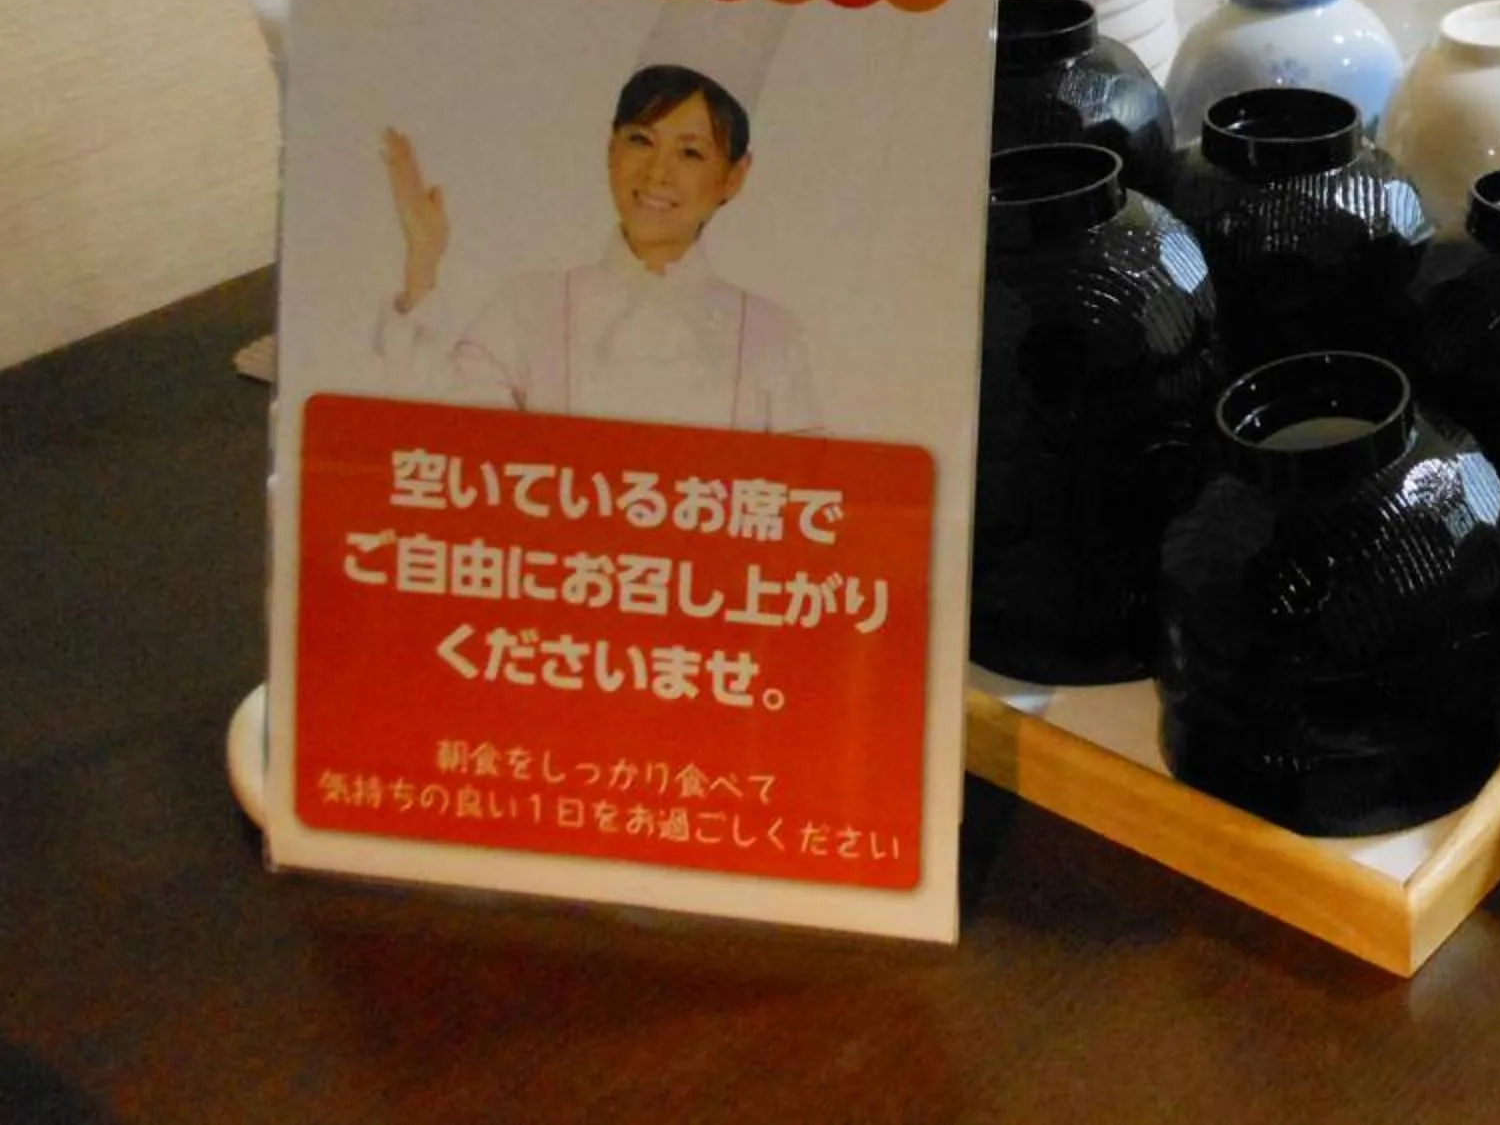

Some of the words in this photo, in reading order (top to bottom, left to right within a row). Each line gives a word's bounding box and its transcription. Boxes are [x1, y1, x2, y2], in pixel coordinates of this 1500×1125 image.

[389, 448, 844, 545] 空いているお席で
[342, 529, 889, 634] ご自由にお召し上がり
[436, 623, 785, 712] くださいませ。
[436, 739, 777, 805] 朝食をしっかり食べて
